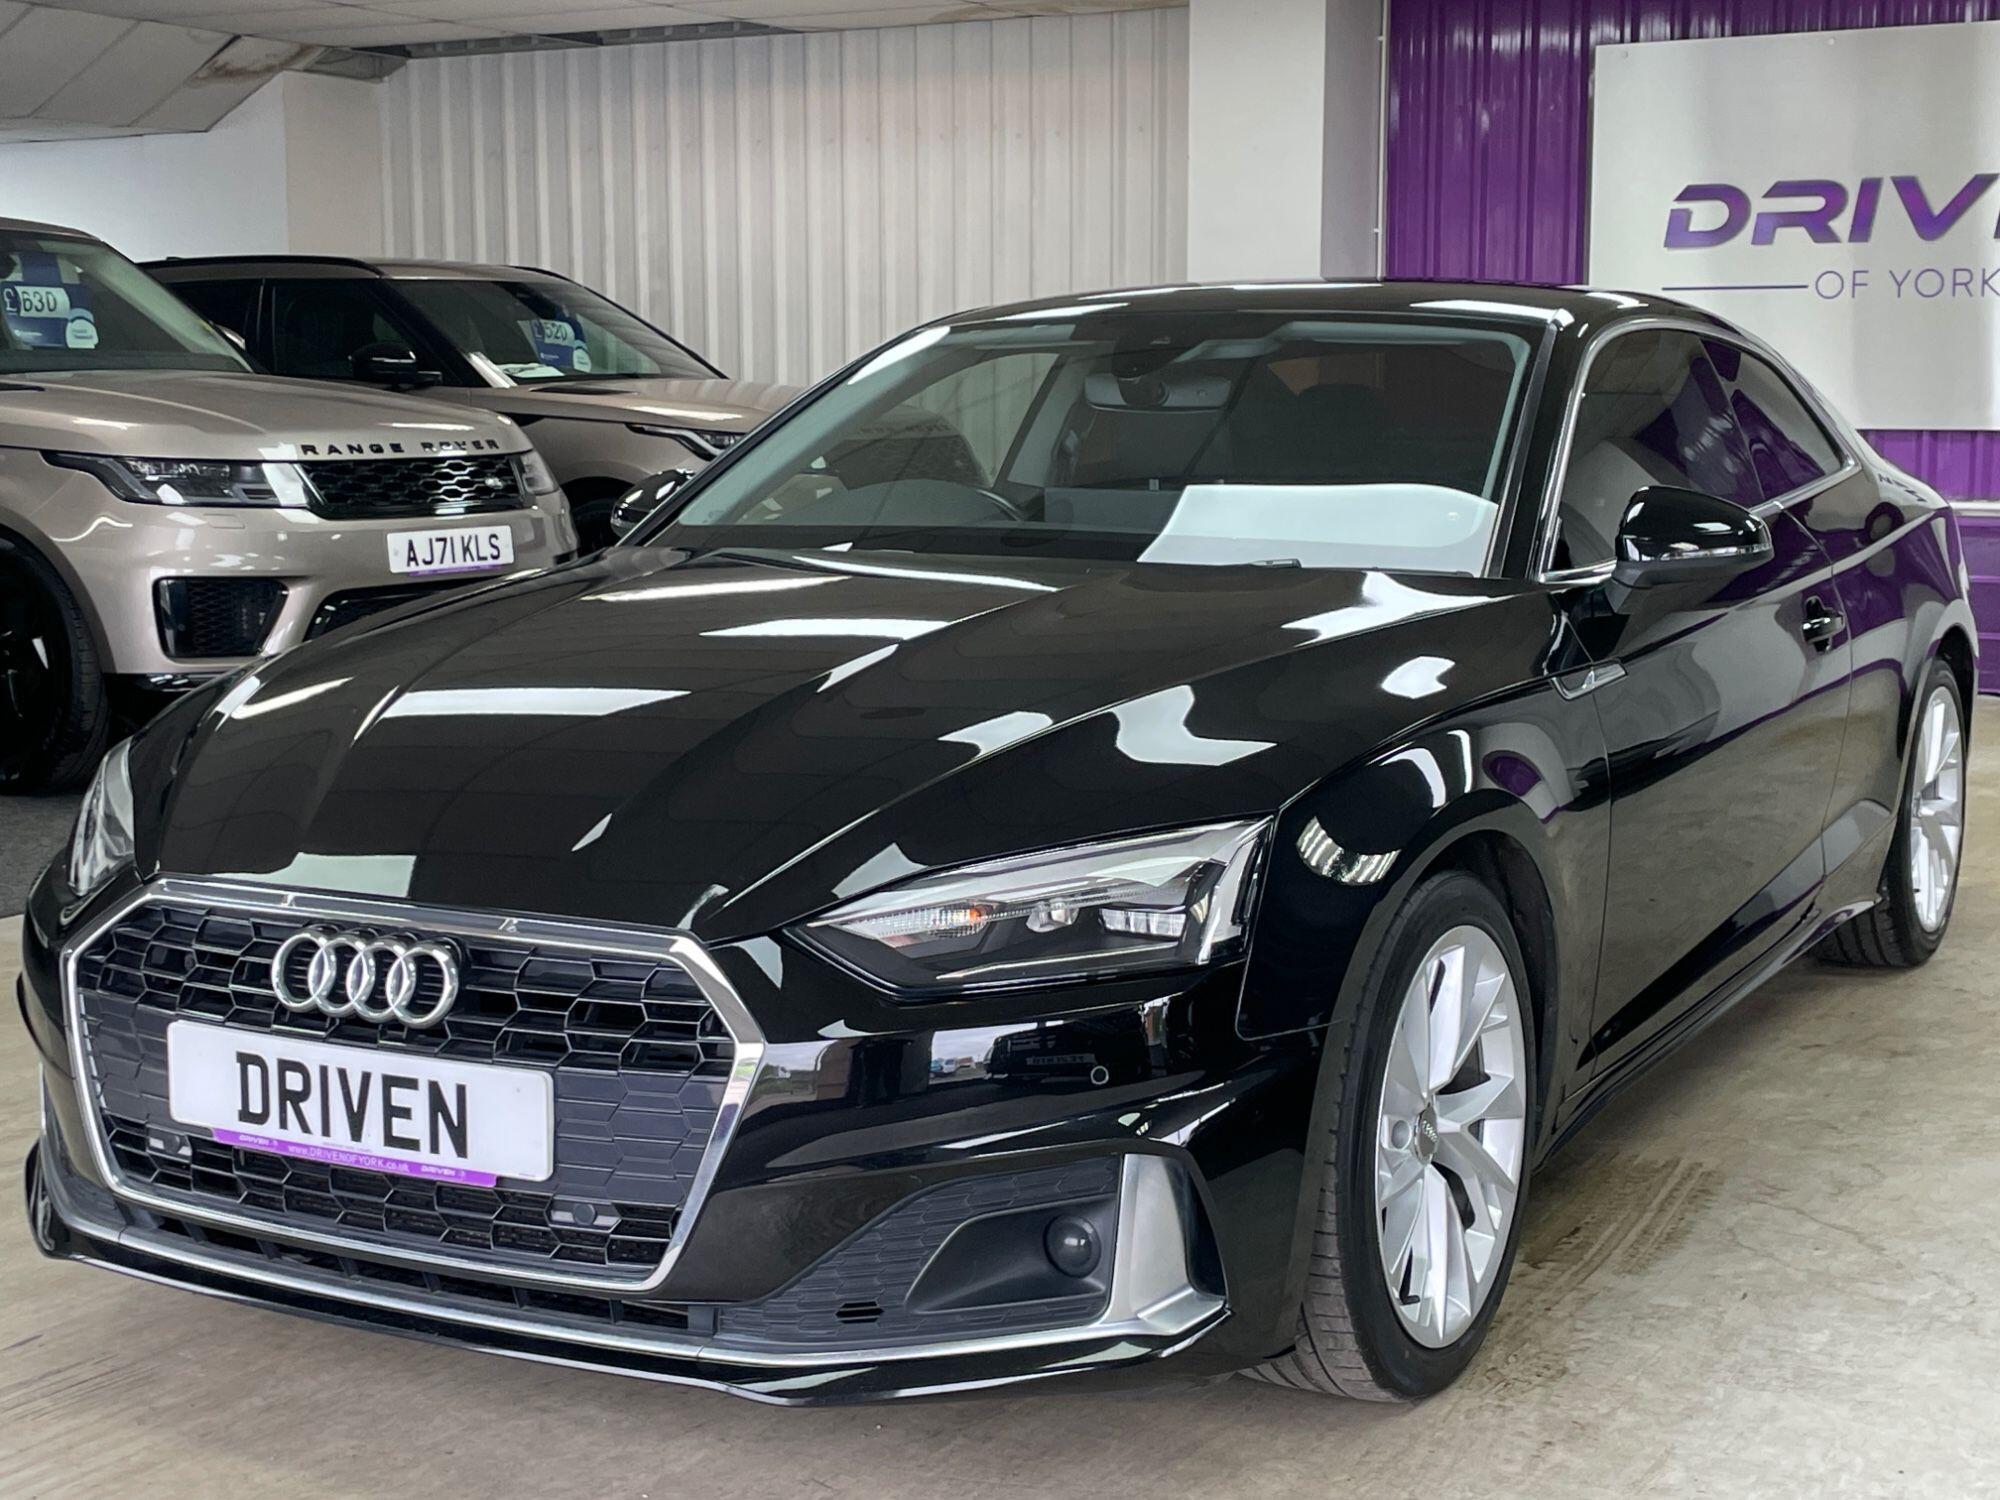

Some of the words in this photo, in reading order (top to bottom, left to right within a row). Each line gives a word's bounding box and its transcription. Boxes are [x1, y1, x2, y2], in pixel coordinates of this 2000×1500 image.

[1664, 173, 2000, 249] DRIV
[1815, 270, 1869, 299] OF
[1889, 268, 2000, 298] YORK
[301, 443, 404, 456] RANGE
[420, 439, 500, 452] ROVER
[406, 537, 455, 567] AJ71
[462, 534, 501, 563] KLS
[235, 1051, 468, 1159] DRIVEN
